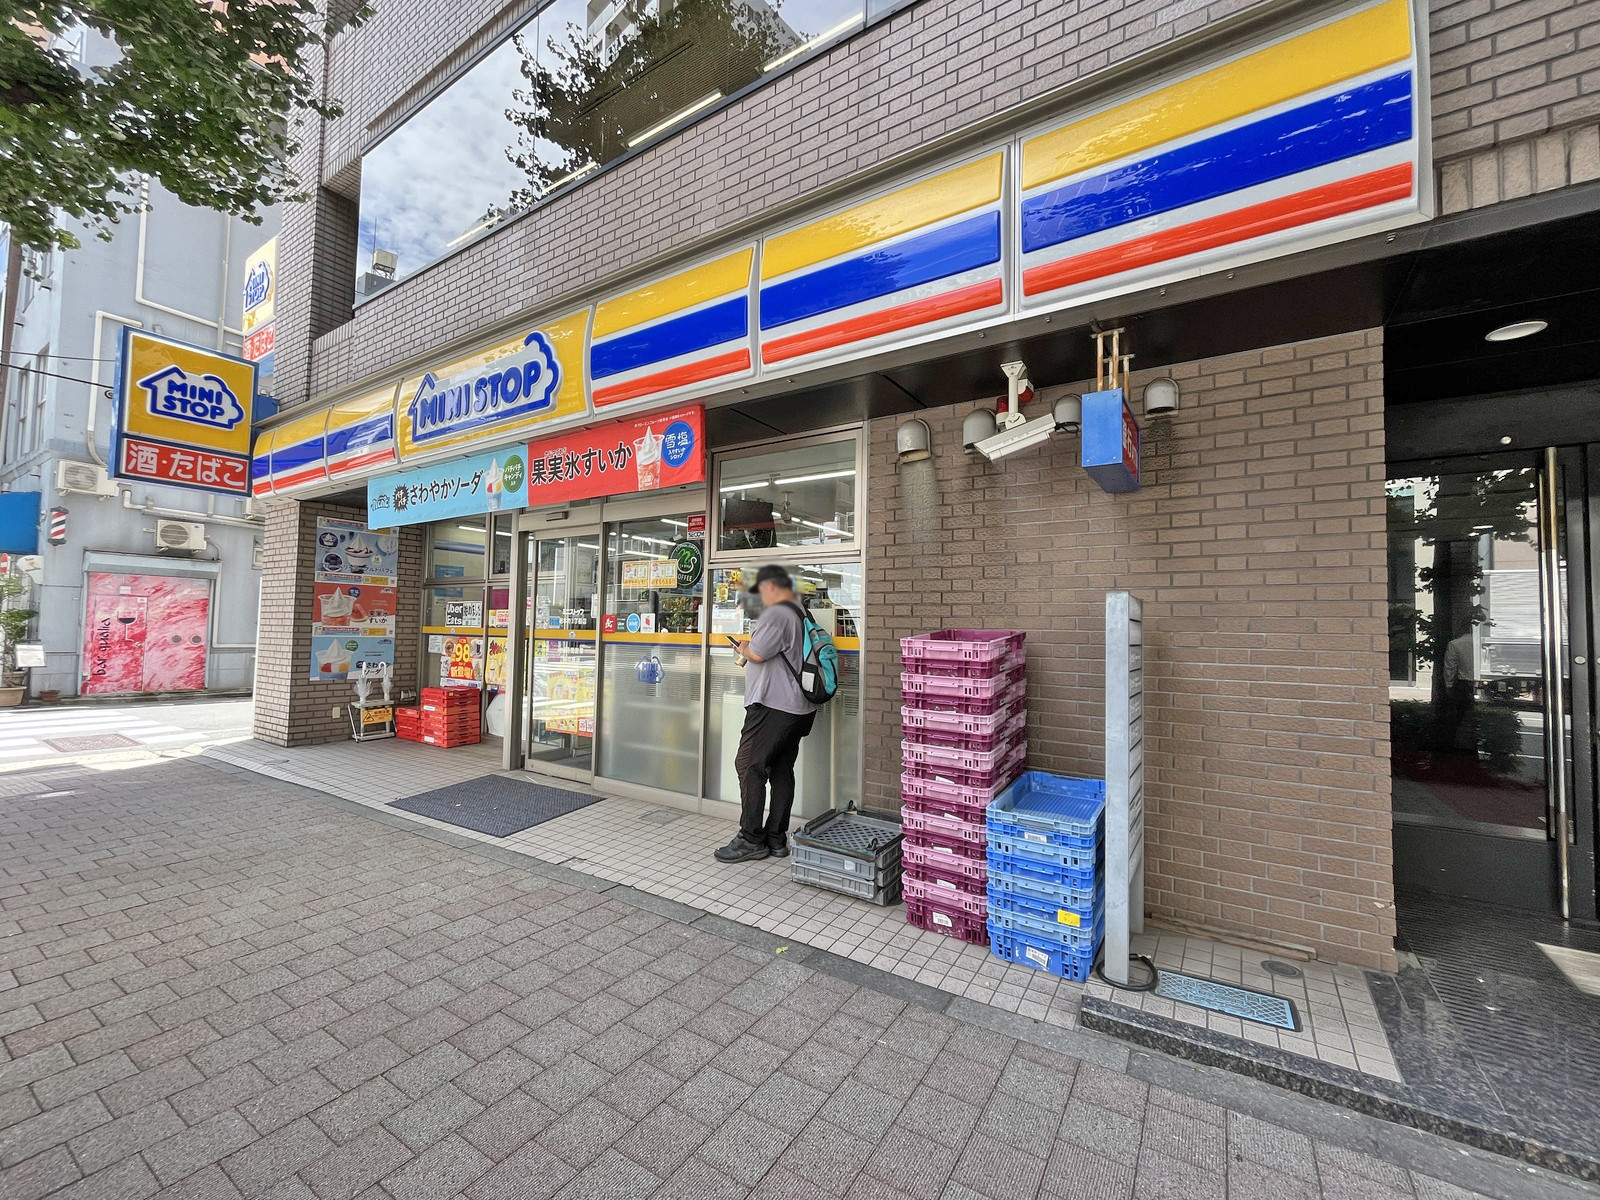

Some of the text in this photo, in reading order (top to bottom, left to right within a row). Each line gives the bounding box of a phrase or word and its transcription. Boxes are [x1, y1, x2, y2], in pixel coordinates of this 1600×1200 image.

[167, 379, 223, 405] MINI
[420, 360, 542, 428] MINI STOP
[162, 395, 225, 420] STOP
[665, 431, 689, 449] 雪塩
[127, 443, 245, 487] 酒・たばこ
[531, 441, 633, 486] 果実氷すいか
[410, 469, 484, 506] さわやかソーダ
[677, 574, 693, 582] OFFEE
[446, 603, 463, 614] Uber
[447, 615, 462, 625] Eats
[92, 618, 111, 676] bar qualia
[455, 643, 471, 663] 98
